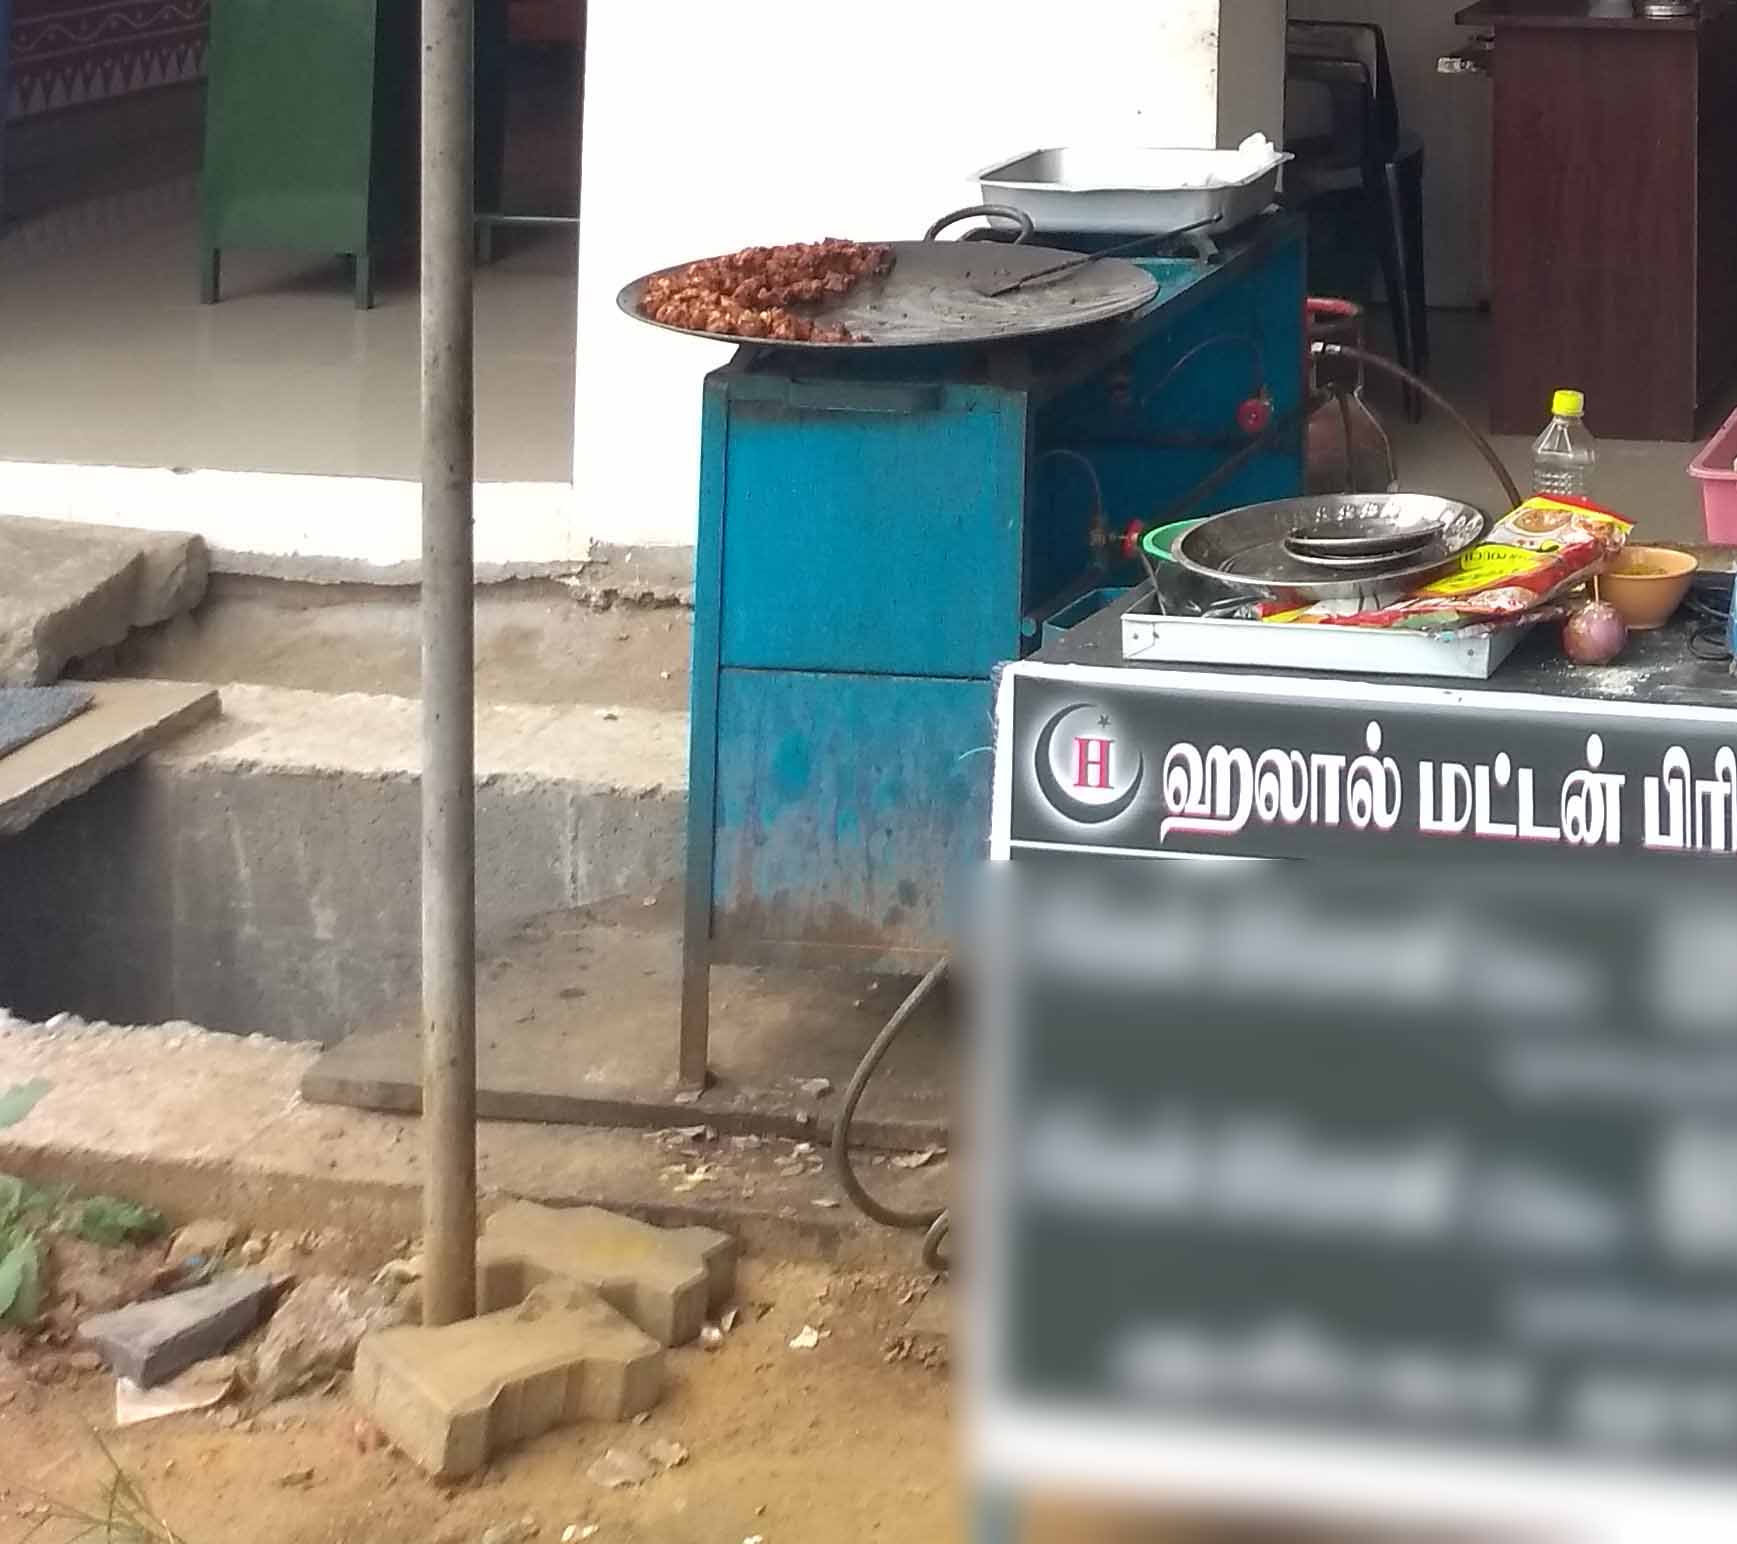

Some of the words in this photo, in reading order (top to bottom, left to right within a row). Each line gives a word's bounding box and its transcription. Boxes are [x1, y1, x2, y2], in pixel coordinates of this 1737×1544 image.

[1072, 736, 1115, 790] H
[1160, 720, 1401, 843] ஹலால்
[1418, 733, 1626, 845] மட்டன்
